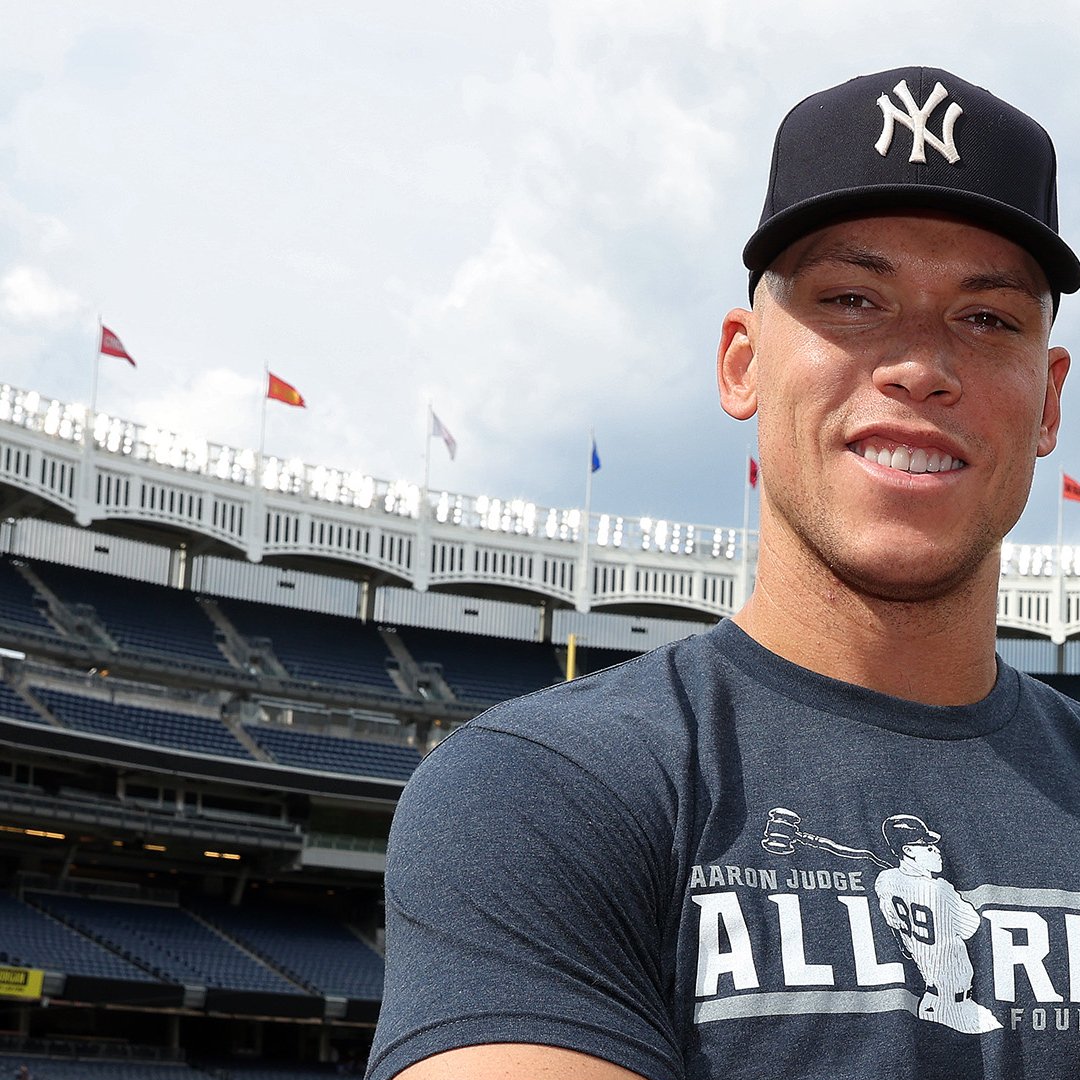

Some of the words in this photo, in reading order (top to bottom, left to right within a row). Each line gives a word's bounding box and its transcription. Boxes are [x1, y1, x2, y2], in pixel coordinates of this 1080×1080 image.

[874, 79, 963, 163] NY
[690, 865, 778, 890] AARON
[786, 868, 866, 891] JUDGE
[692, 892, 905, 997] ALL
[892, 895, 936, 946] 99
